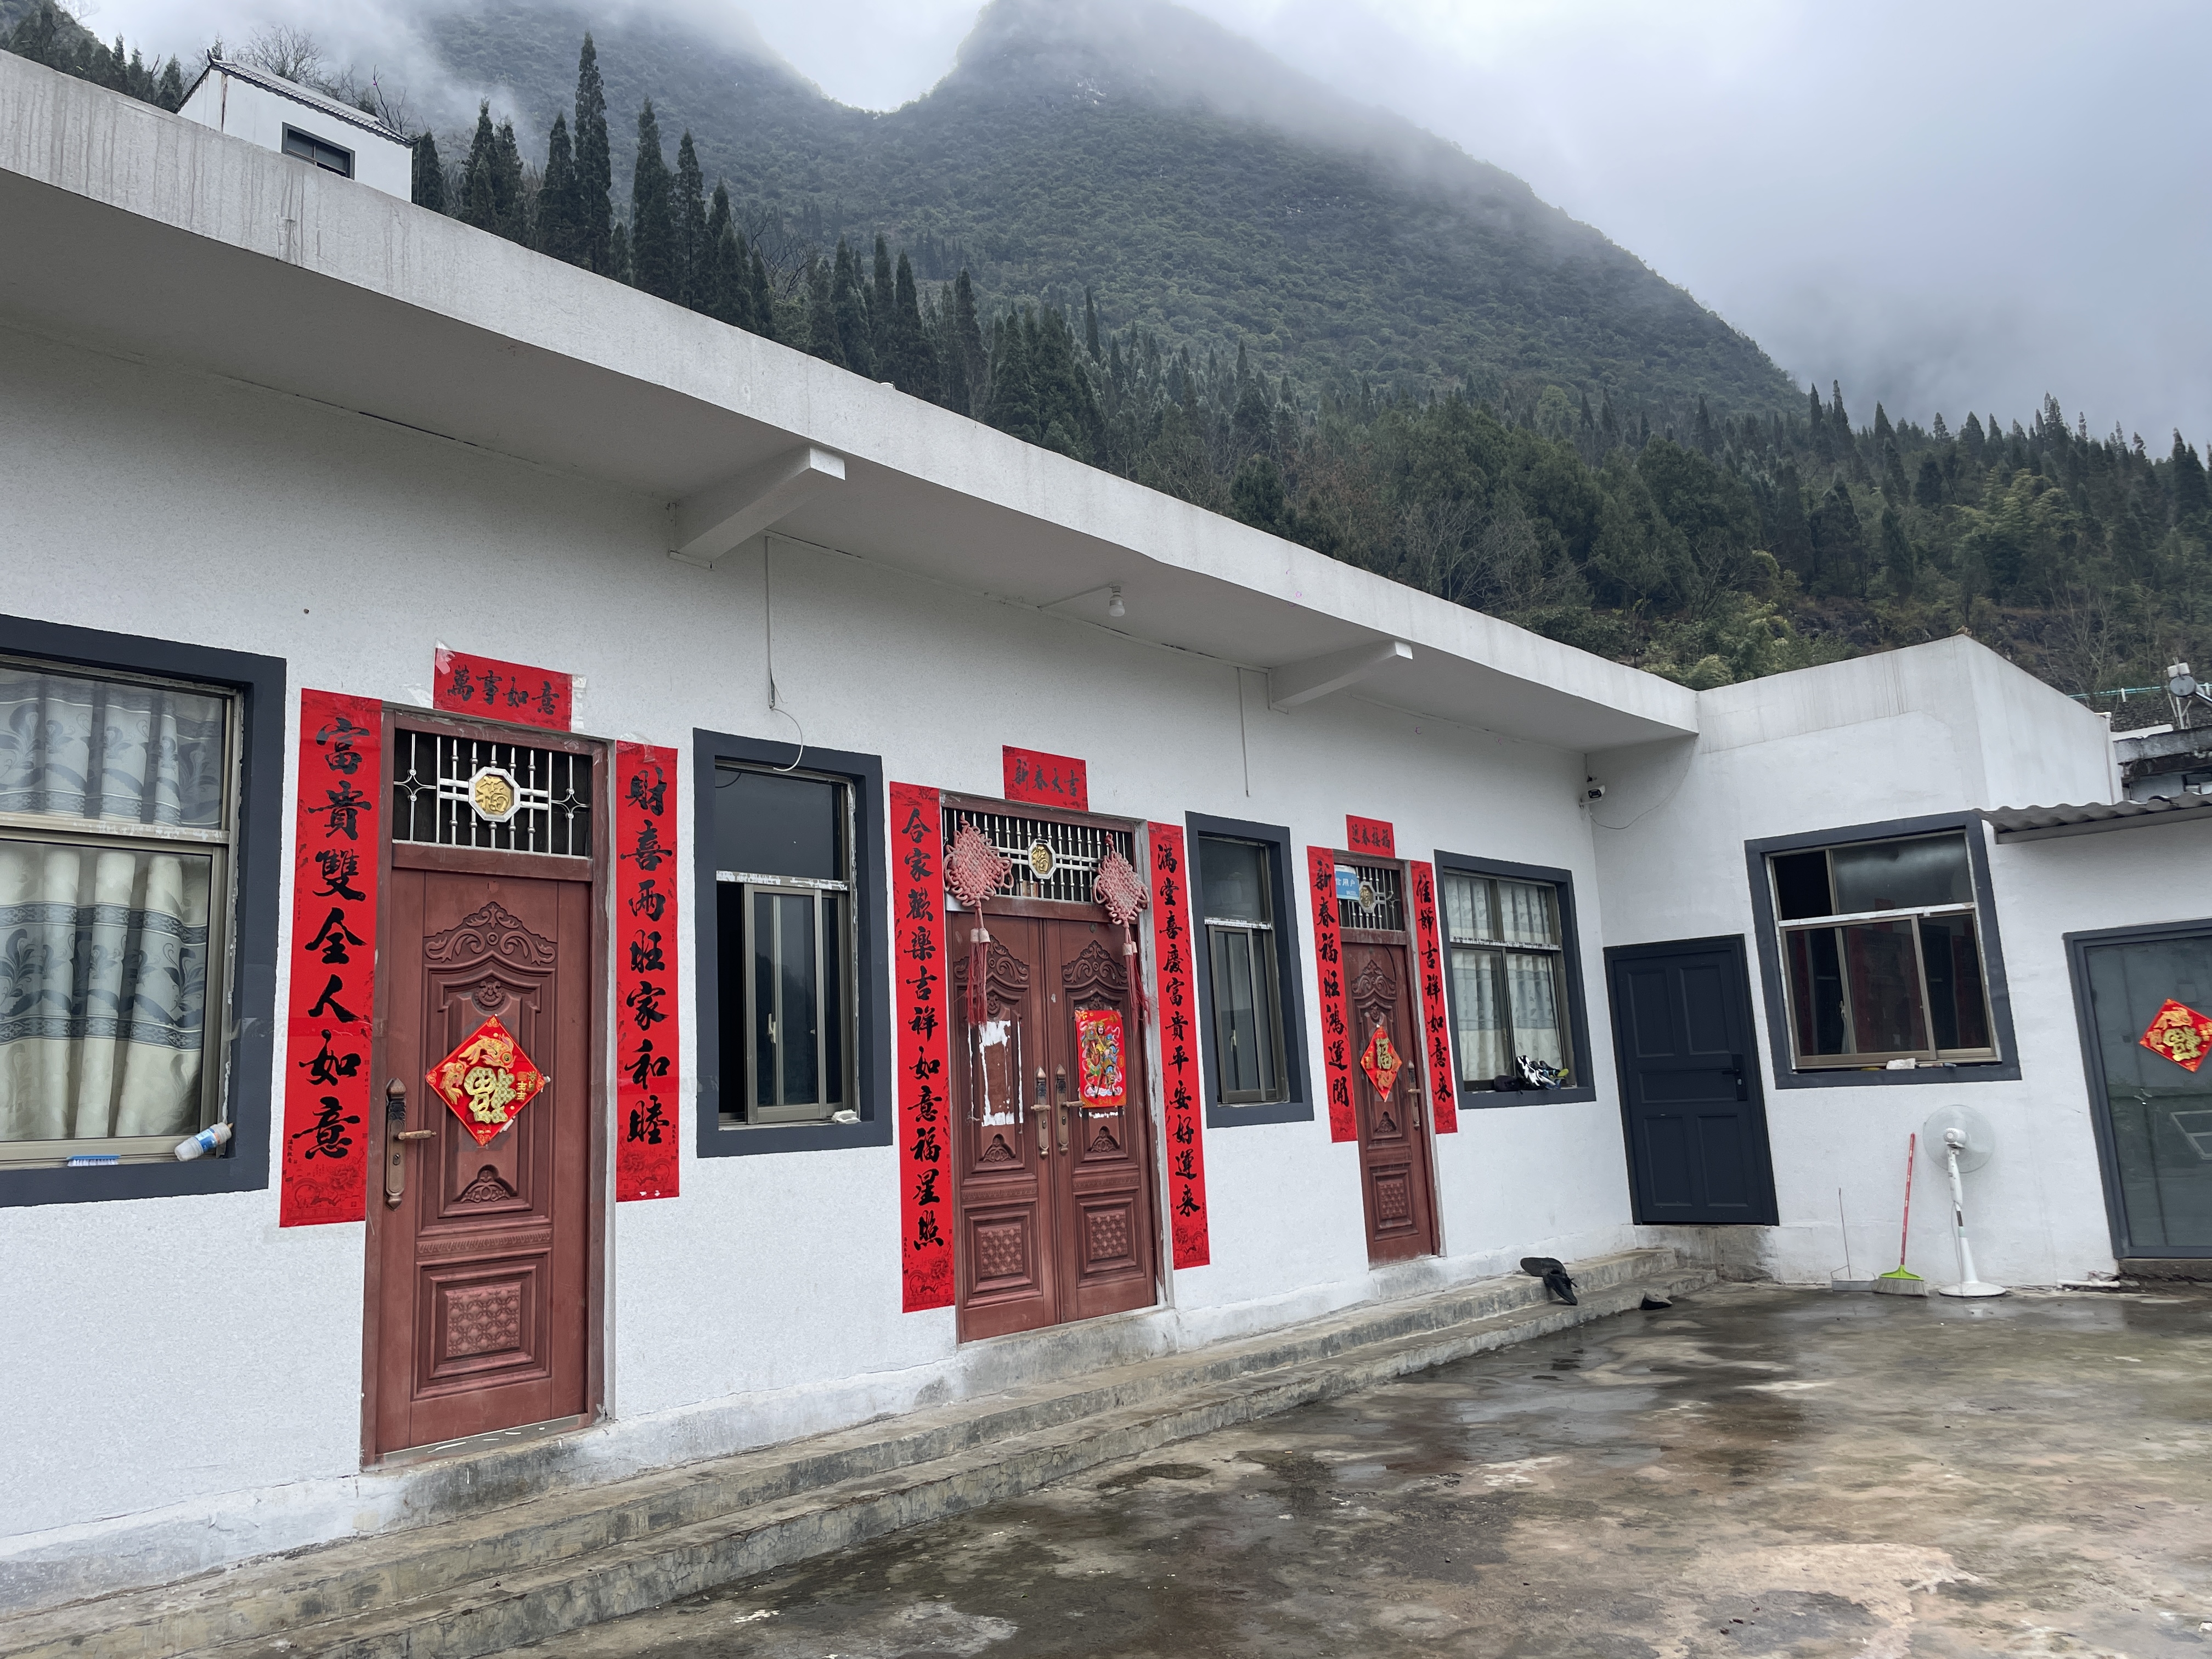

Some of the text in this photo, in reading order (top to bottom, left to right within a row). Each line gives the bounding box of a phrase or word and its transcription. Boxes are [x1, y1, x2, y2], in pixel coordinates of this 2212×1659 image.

[447, 664, 560, 715] 萬事如意
[1012, 759, 1079, 797] 新春大吉
[292, 717, 371, 1160] 富貴雙全人如意
[464, 1066, 517, 1124] 福
